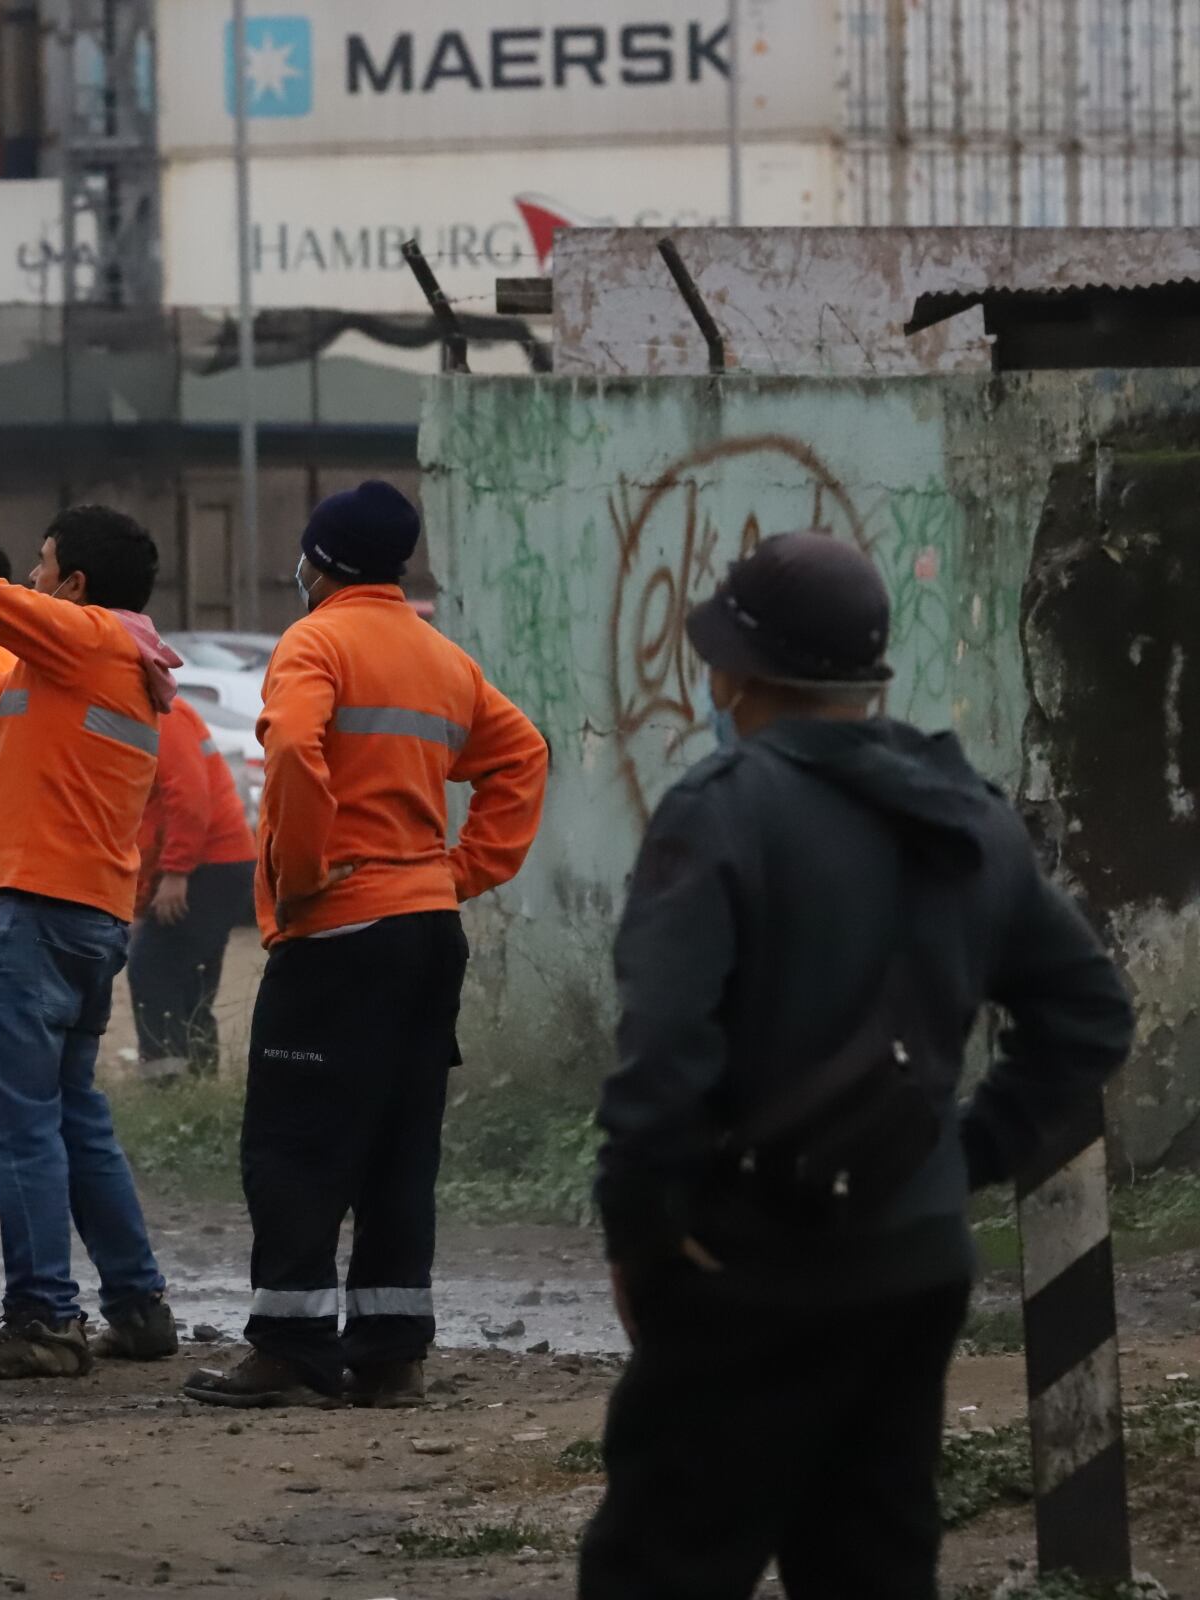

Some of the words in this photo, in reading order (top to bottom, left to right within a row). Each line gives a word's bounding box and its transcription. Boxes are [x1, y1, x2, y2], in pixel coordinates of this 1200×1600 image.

[345, 21, 732, 94] MAERSK
[264, 1048, 289, 1059] PUERTO
[291, 1051, 323, 1062] CENTRAL
